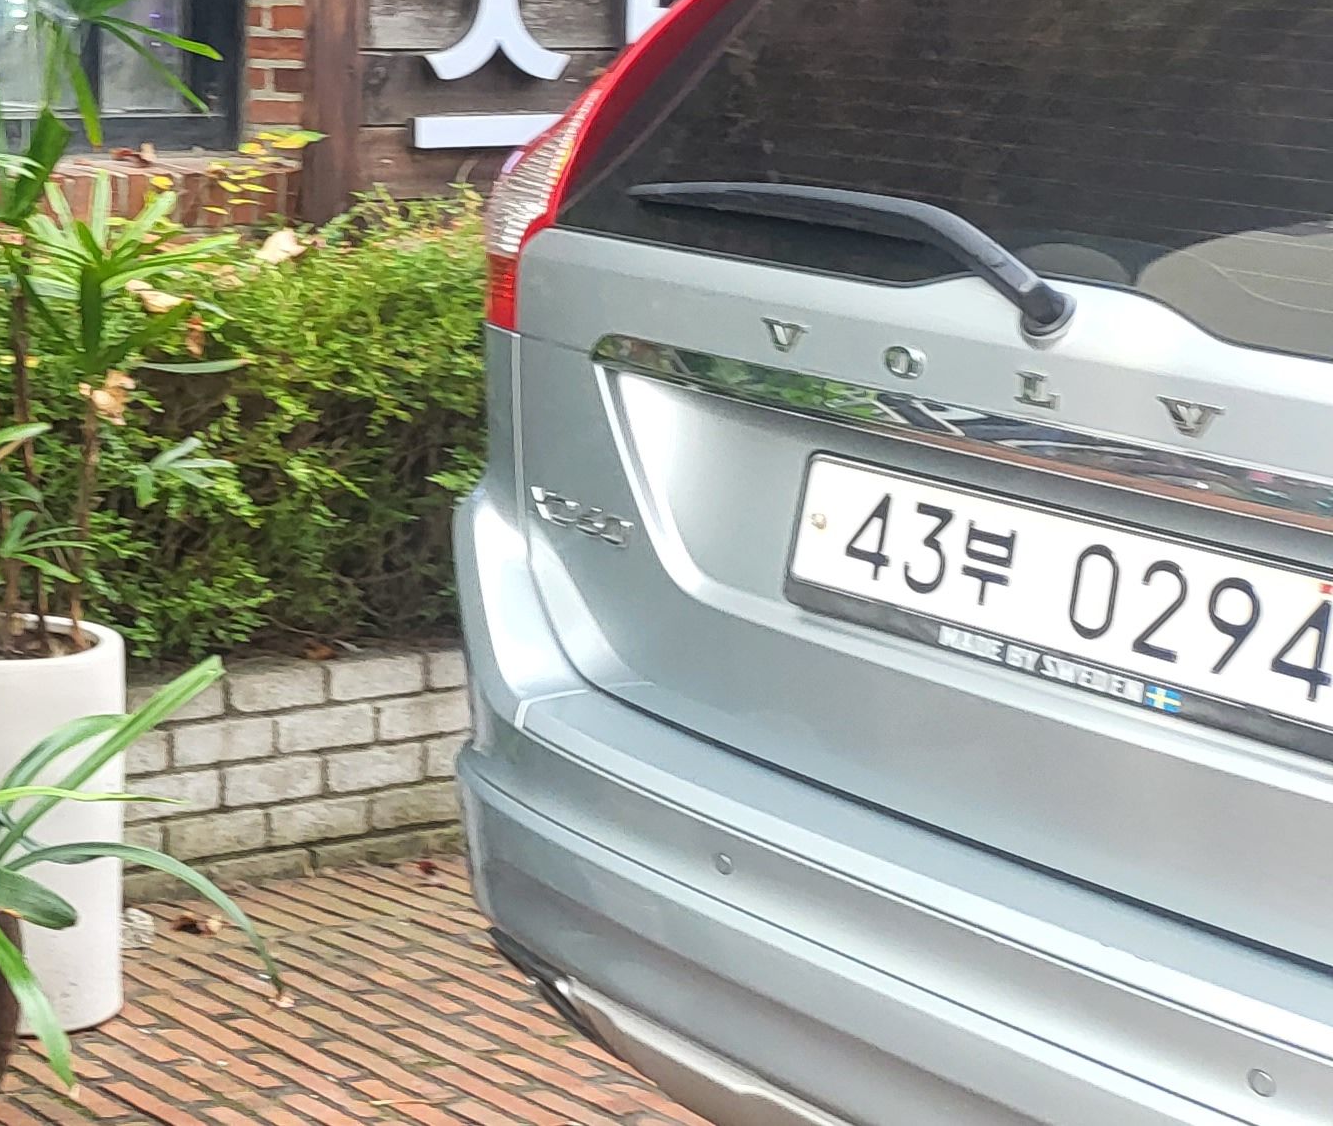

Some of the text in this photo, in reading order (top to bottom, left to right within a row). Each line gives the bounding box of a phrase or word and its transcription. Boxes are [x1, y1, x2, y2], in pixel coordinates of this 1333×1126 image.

[844, 492, 1333, 703] 43부 0294
[1038, 653, 1146, 705] SWEDEN
